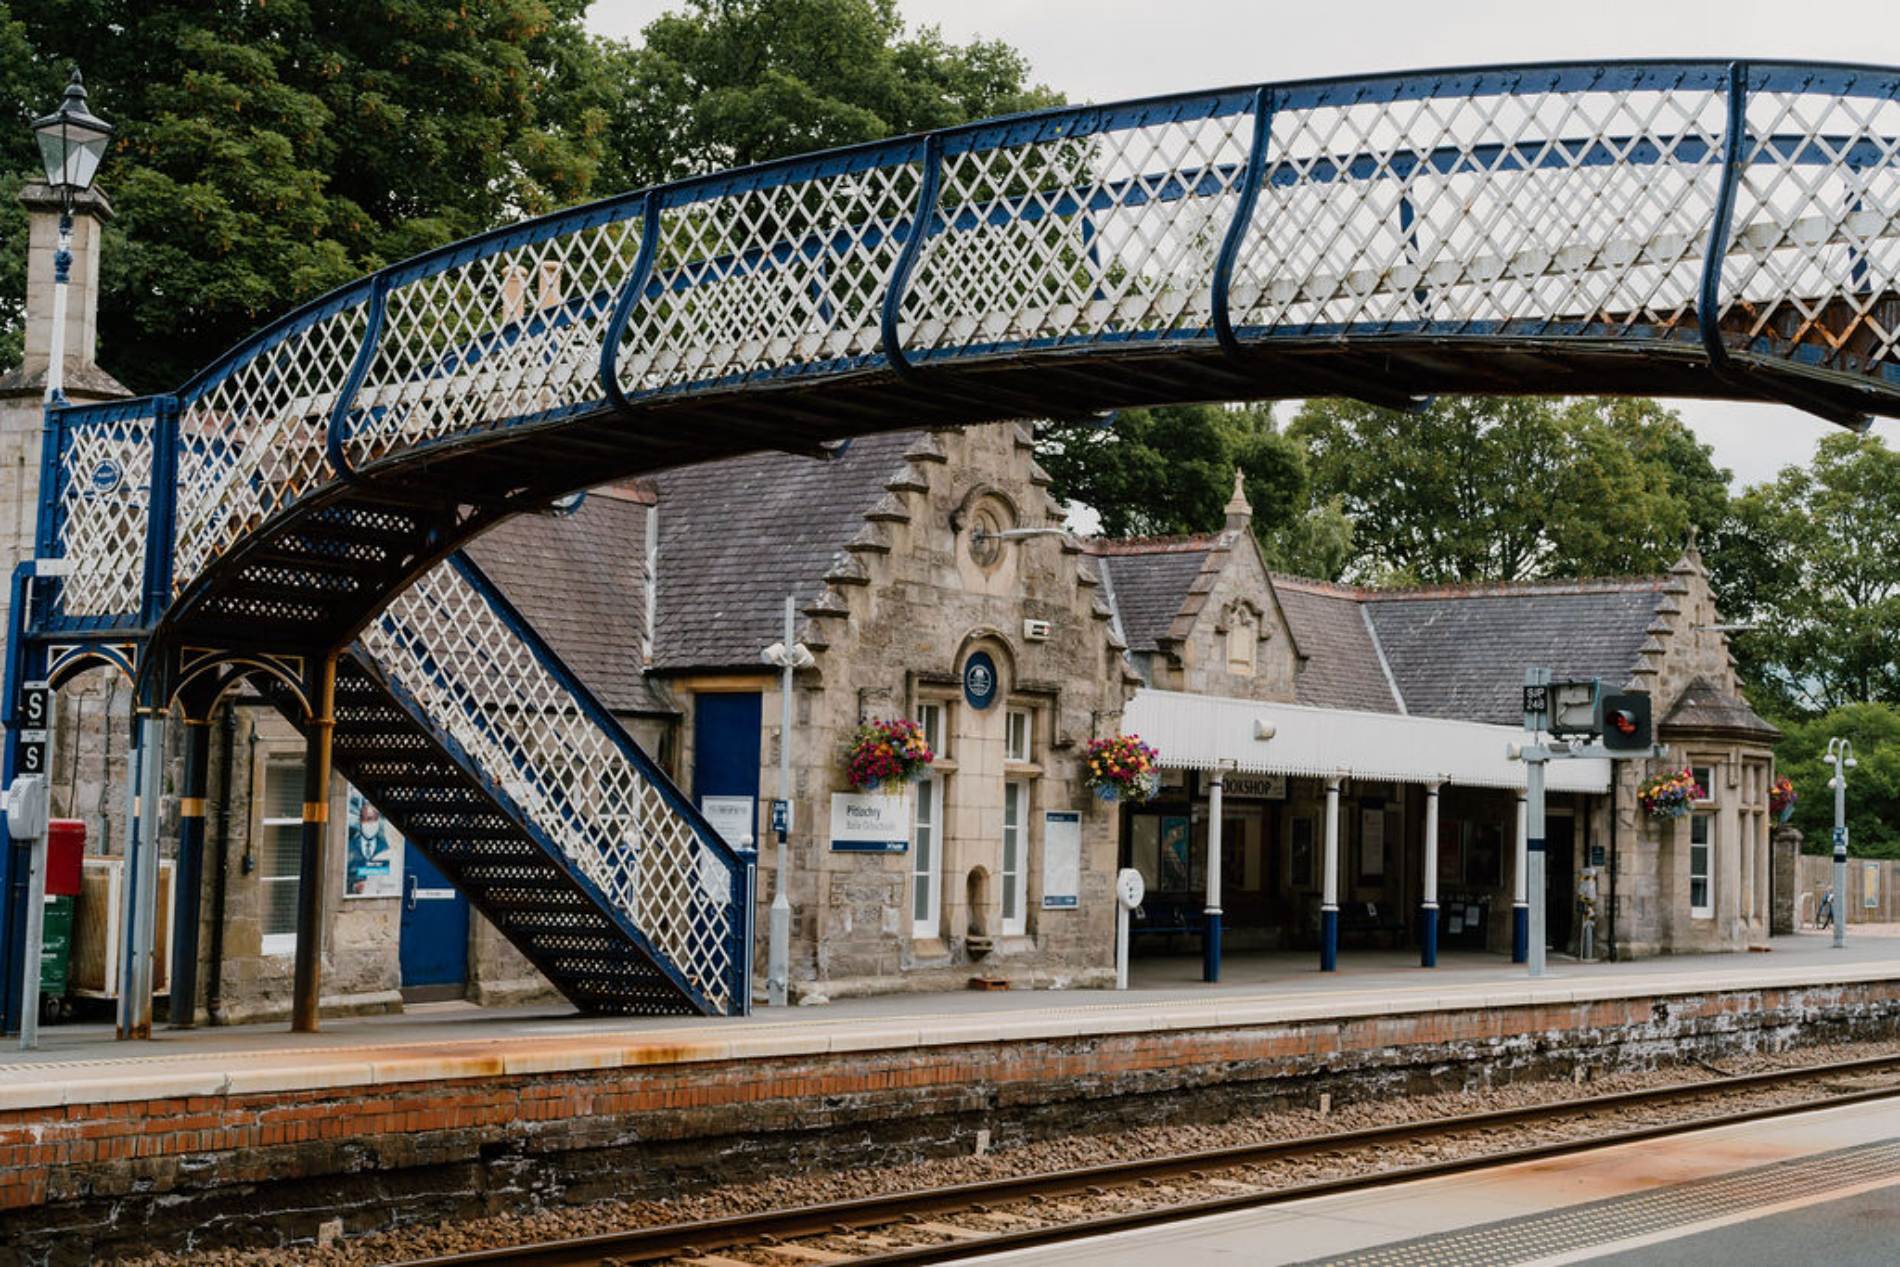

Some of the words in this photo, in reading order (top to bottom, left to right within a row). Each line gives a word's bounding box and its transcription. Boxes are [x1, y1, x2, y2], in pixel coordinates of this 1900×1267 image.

[28, 692, 42, 719] S
[26, 746, 39, 770] S
[1221, 779, 1272, 795] OOKSHOP
